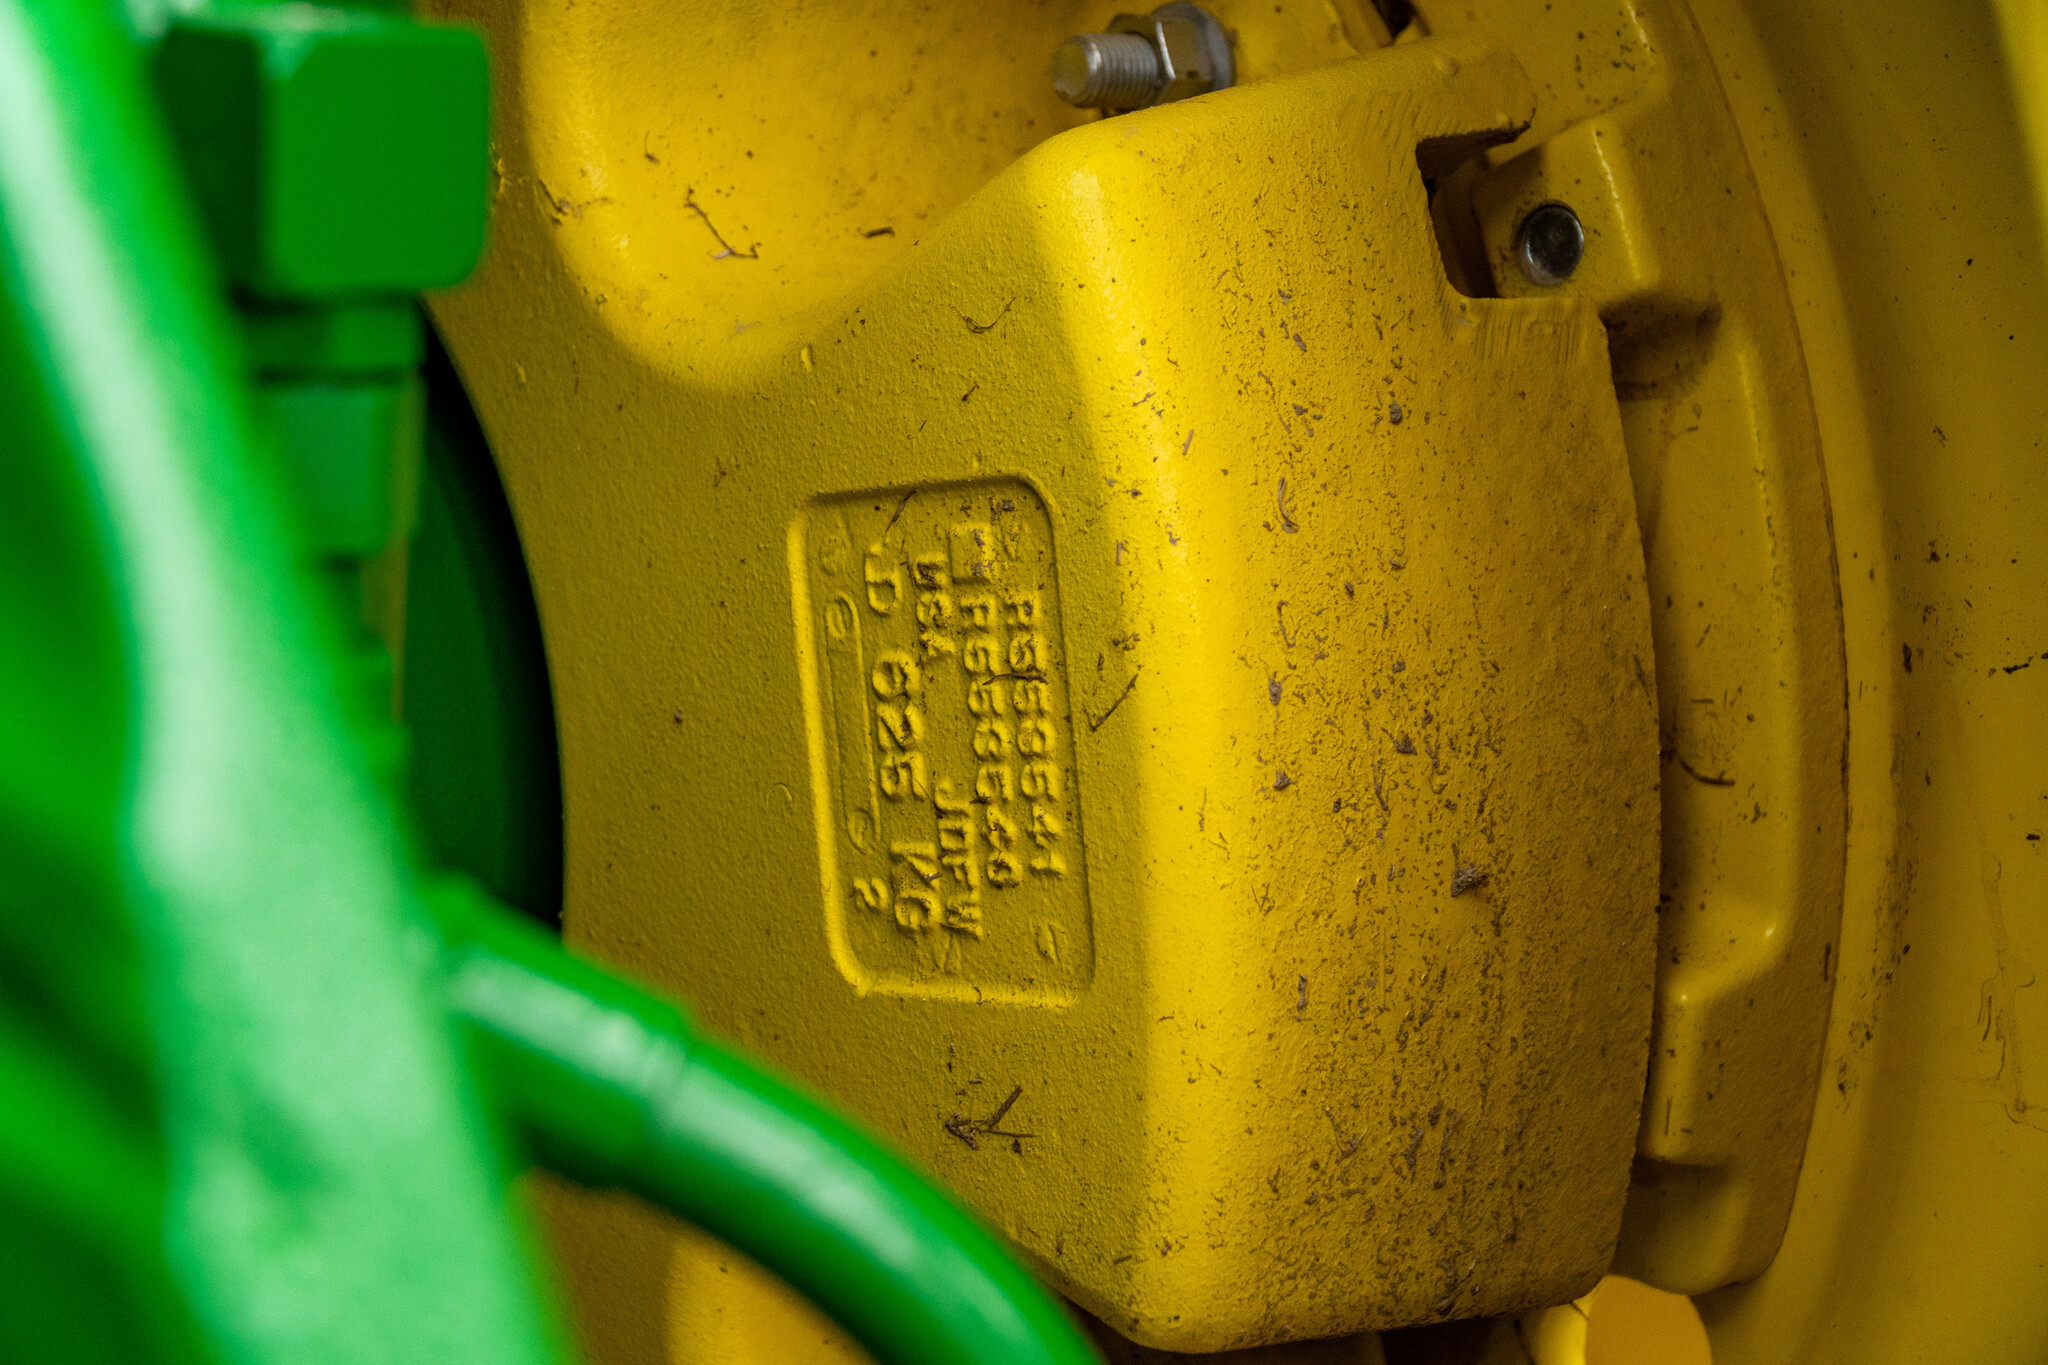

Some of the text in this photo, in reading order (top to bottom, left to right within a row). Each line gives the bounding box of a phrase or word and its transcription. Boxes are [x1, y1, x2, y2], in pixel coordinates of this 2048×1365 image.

[871, 649, 926, 799] 625
[915, 556, 983, 941] USA JDFW
[890, 842, 940, 937] KG
